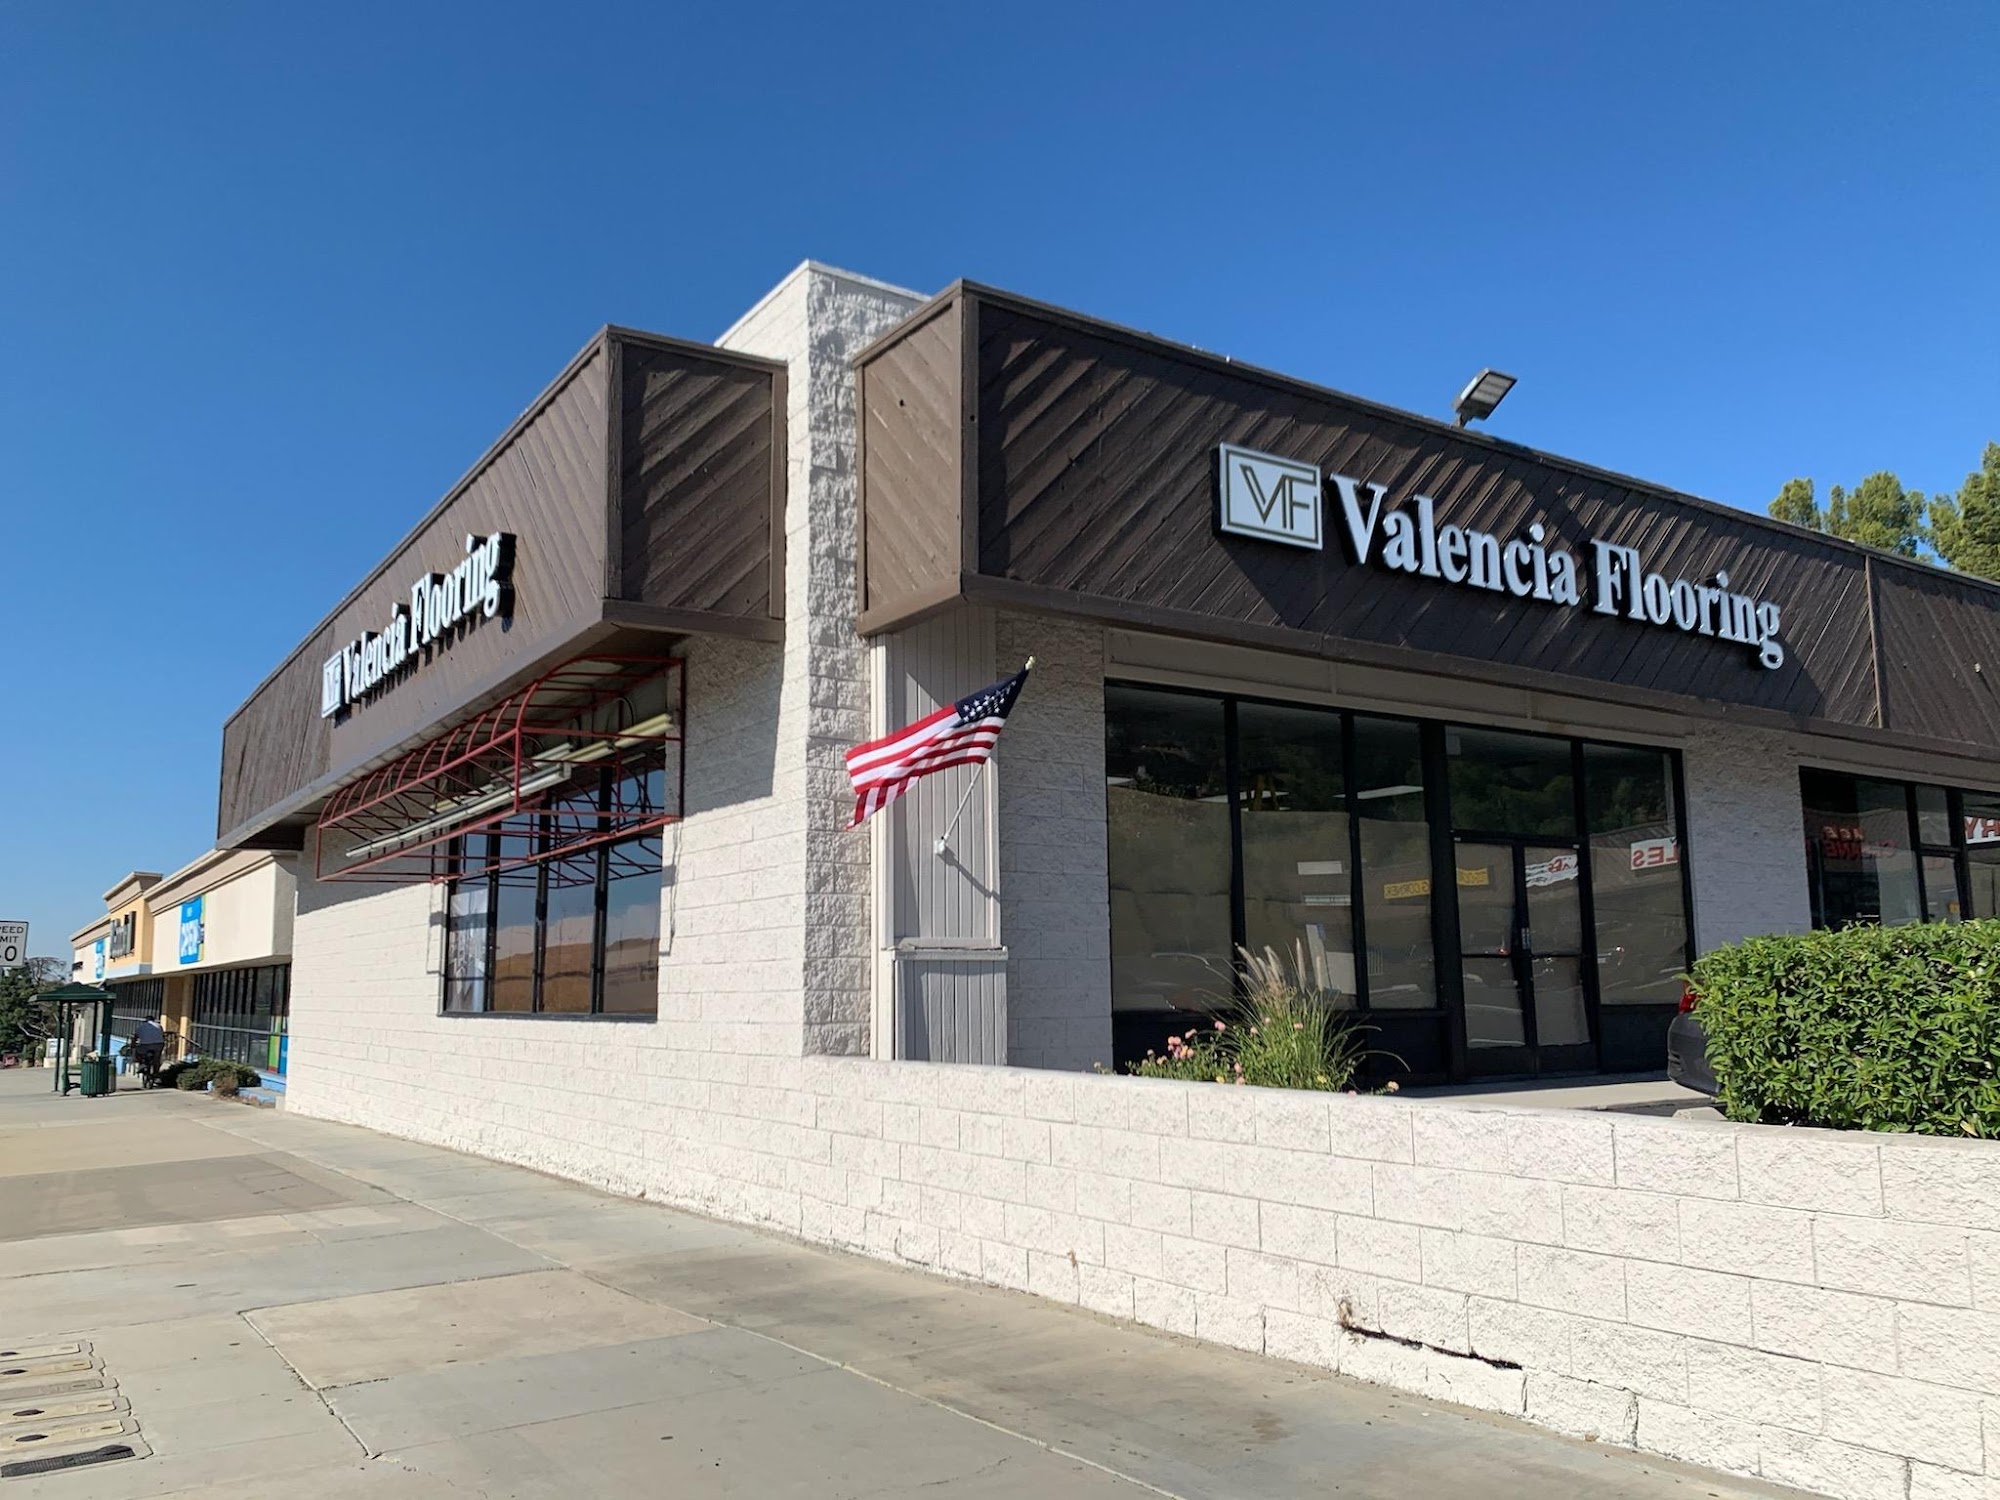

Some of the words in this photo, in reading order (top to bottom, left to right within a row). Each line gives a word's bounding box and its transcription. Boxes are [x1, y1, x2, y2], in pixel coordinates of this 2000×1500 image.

[1240, 465, 1317, 530] VF
[1330, 473, 1580, 606] Valencia
[1589, 538, 1784, 670] Flooring
[341, 602, 410, 704] Valencia
[408, 531, 501, 654] Flooring
[0, 926, 24, 934] EED
[0, 945, 17, 961] 0
